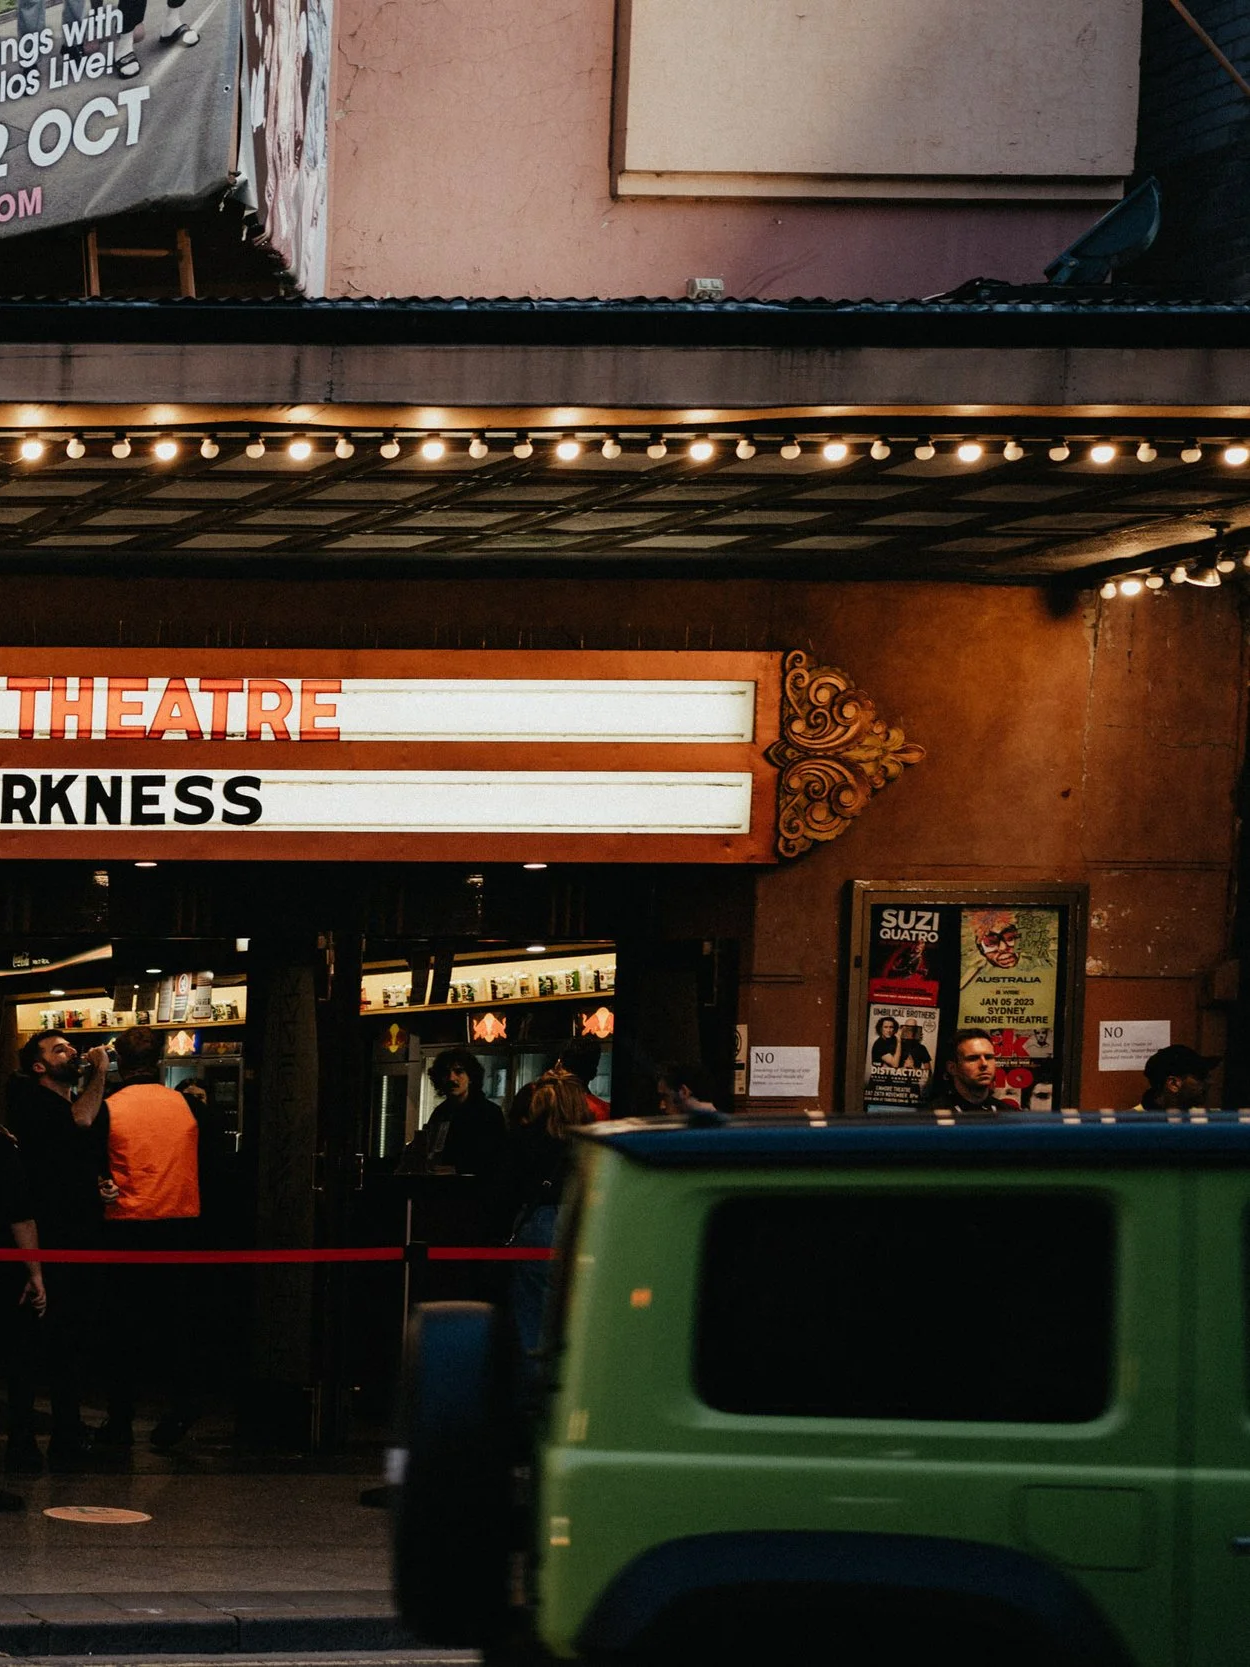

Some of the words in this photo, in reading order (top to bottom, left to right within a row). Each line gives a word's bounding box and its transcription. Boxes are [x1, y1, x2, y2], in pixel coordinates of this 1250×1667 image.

[61, 5, 124, 49] with
[47, 45, 115, 91] Live!
[26, 86, 151, 168] OCT
[7, 676, 343, 741] THEATRE
[880, 908, 940, 931] SUZI
[879, 928, 939, 943] QUATRO
[980, 998, 998, 1006] JAN
[1000, 998, 1012, 1006] 05
[1014, 998, 1035, 1006] 2023
[987, 1007, 1026, 1015] SYDNEY
[964, 1016, 1004, 1024] ENMORE
[1006, 1016, 1048, 1024] THEATRE
[1104, 1026, 1124, 1039] NO
[755, 1052, 775, 1064] NO
[871, 1066, 929, 1077] DISTRACTION
